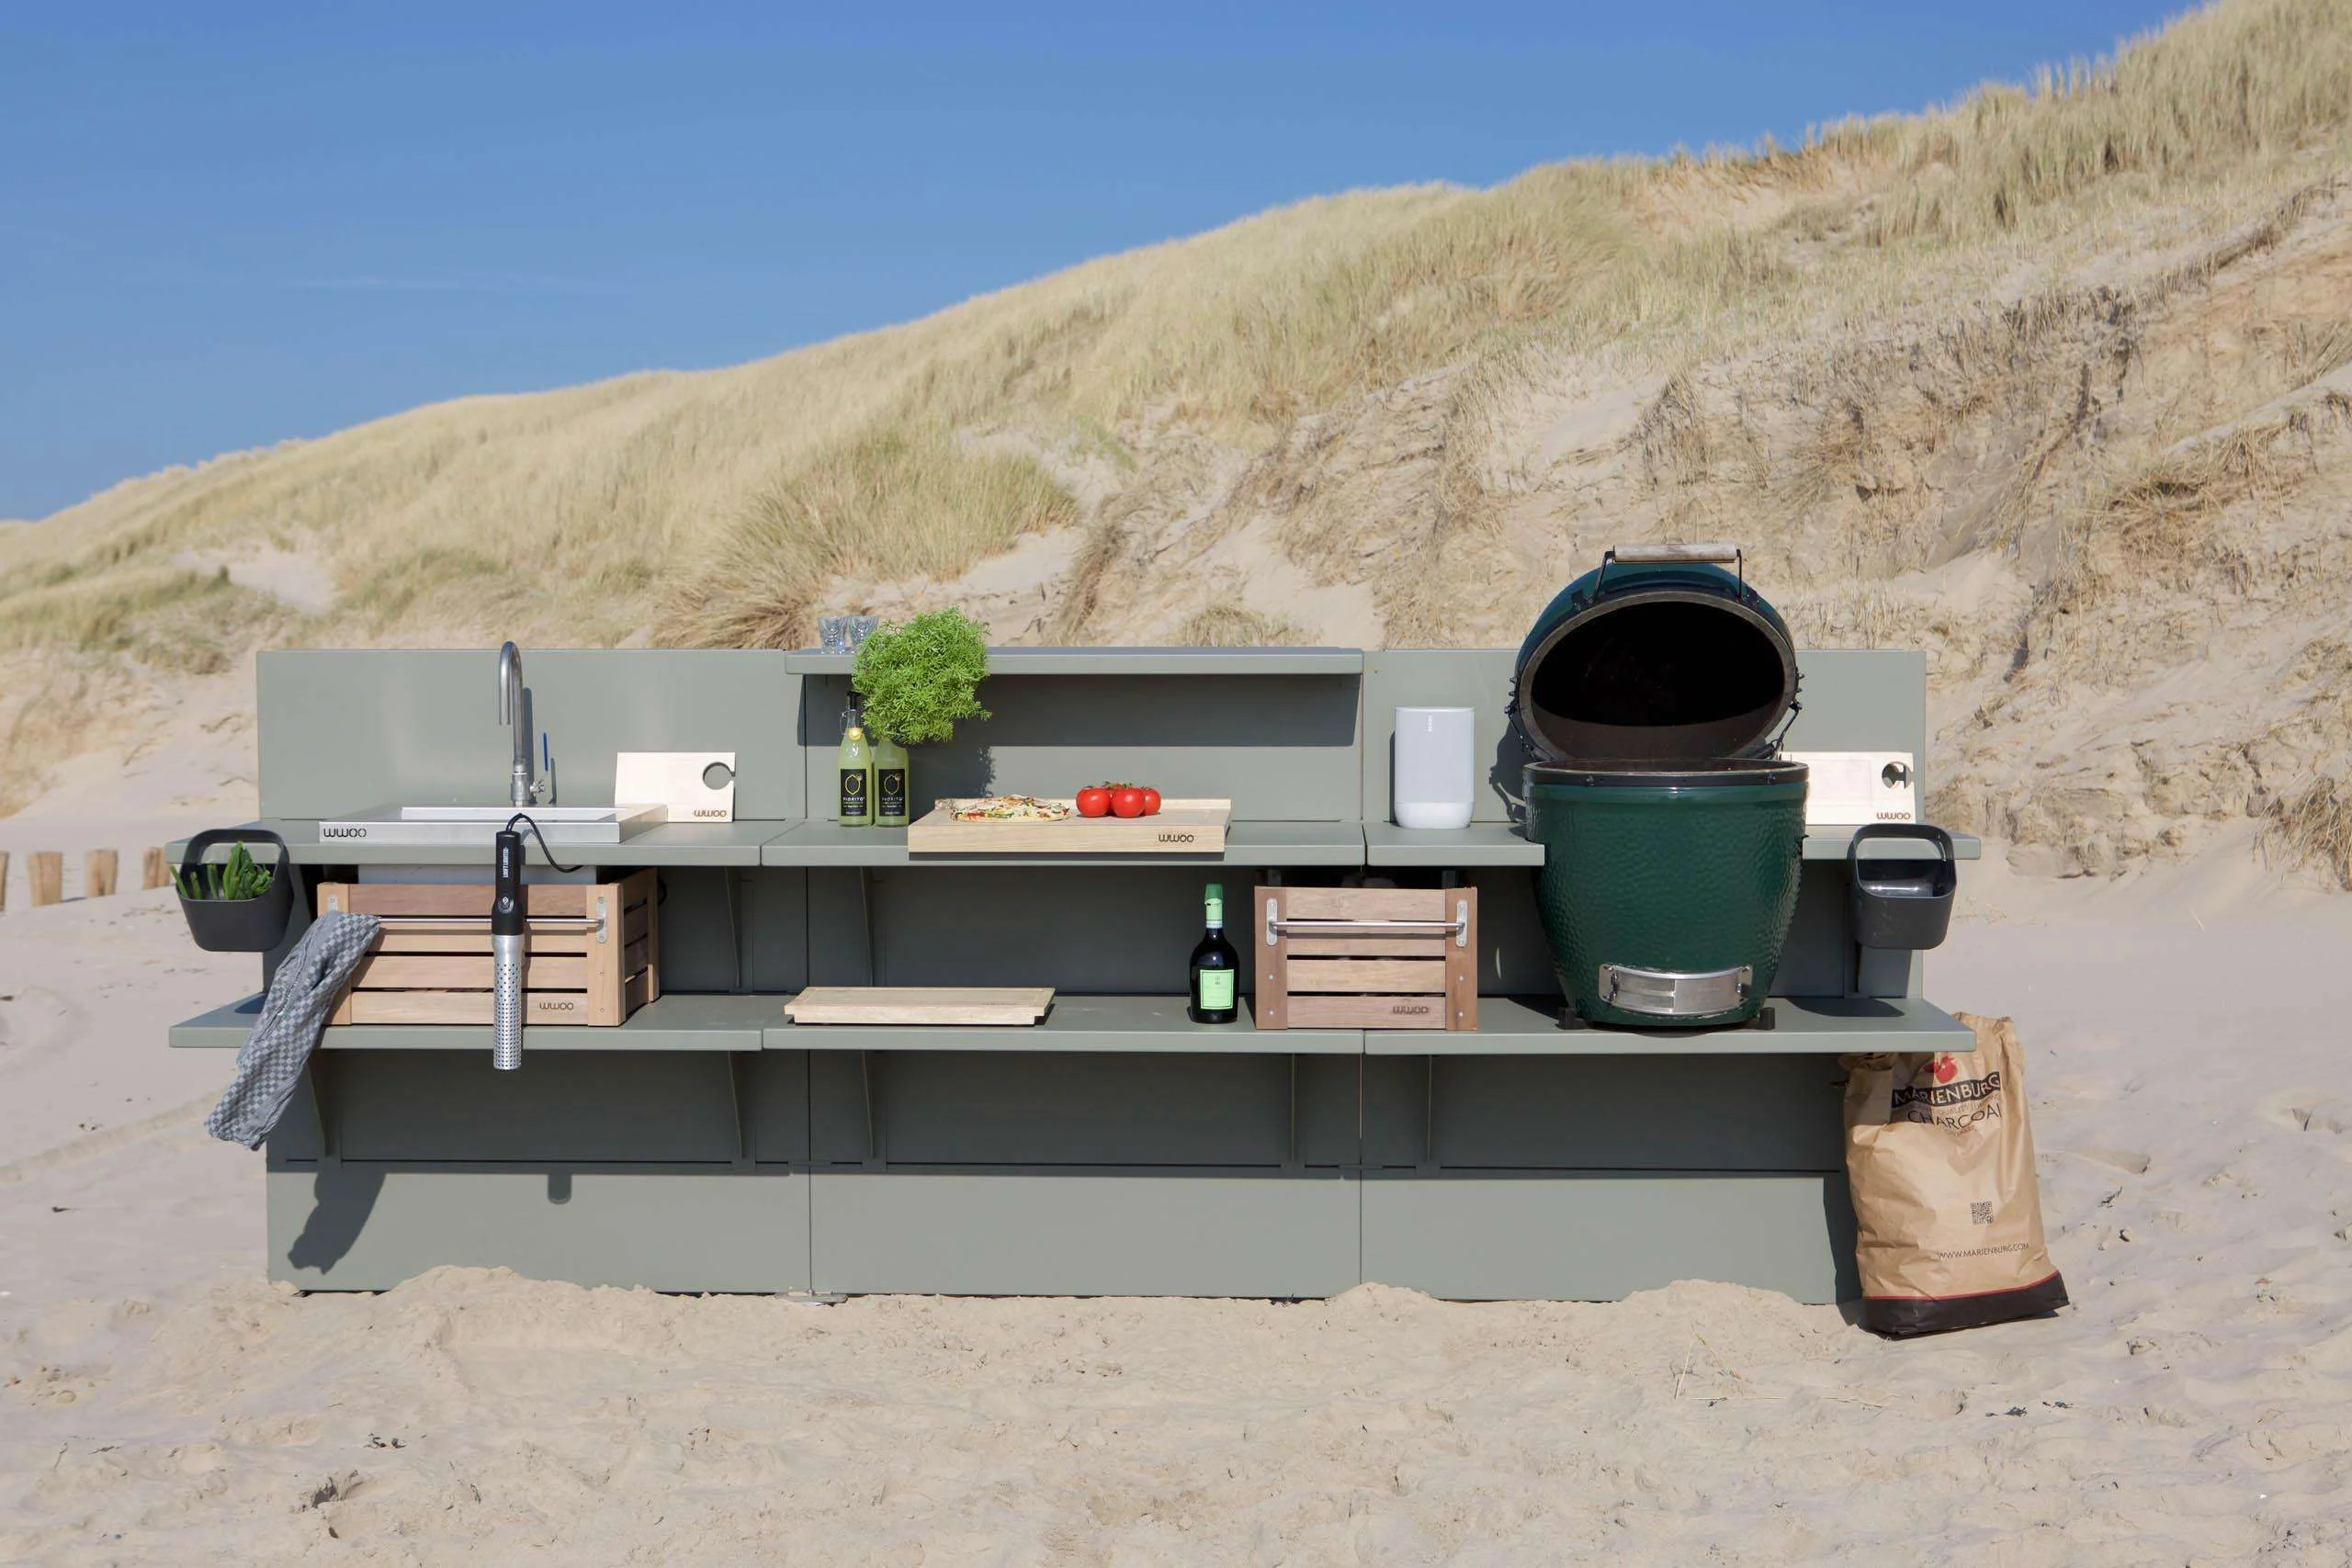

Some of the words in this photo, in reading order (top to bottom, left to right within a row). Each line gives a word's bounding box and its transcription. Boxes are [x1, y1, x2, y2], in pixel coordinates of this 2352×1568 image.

[323, 828, 367, 838] WWOO
[1159, 834, 1194, 842] WWOO
[1894, 1074, 2000, 1105] MARIENBURG
